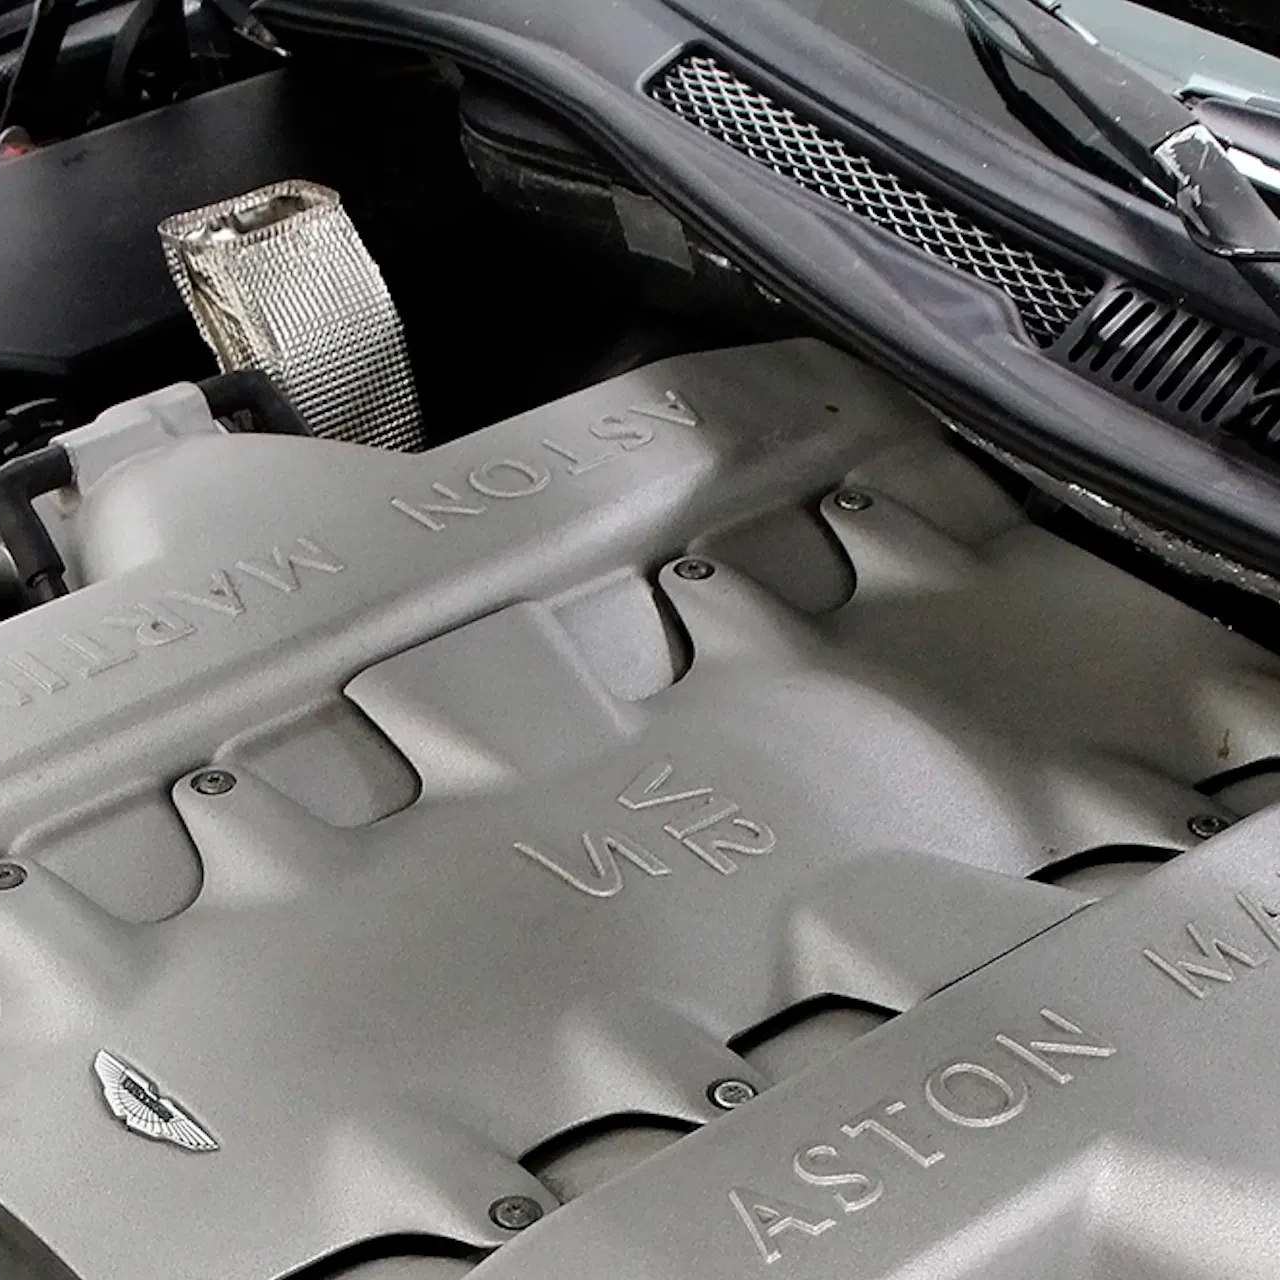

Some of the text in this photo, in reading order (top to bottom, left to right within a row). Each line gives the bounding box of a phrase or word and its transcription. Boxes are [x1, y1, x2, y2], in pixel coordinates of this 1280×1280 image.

[390, 387, 703, 533] ASTON
[617, 755, 777, 876] V12
[728, 1006, 1117, 1264] ASTON
